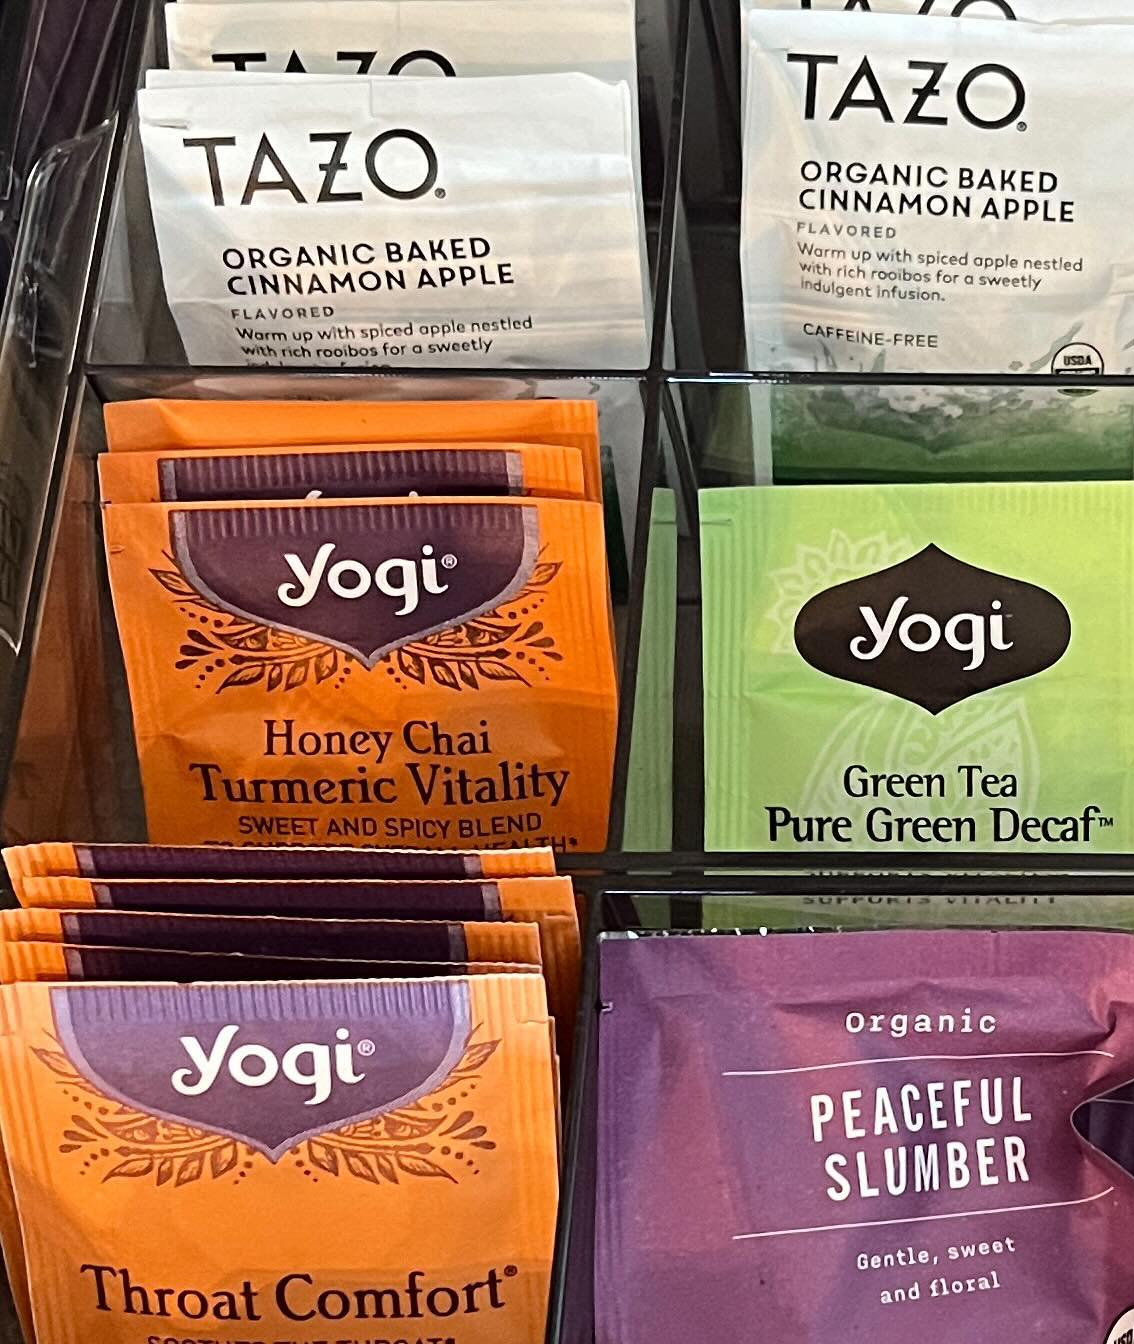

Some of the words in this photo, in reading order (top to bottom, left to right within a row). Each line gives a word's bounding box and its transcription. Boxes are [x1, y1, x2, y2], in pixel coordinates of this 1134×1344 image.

[801, 161, 950, 189] ORGANIC
[959, 167, 1058, 193] BAKED
[800, 189, 971, 218] CINNAMON
[981, 197, 1074, 223] APPLE
[797, 222, 897, 239] FLAVORED
[222, 243, 376, 269] ORGANIC
[386, 237, 490, 263] BAKED
[798, 242, 846, 260] Warm
[851, 251, 871, 264] up
[877, 249, 912, 264] with
[918, 251, 969, 268] spiced
[974, 255, 1018, 270] apple
[1024, 257, 1083, 273] nestled
[227, 269, 406, 295] CINNAMON
[418, 263, 514, 289] APPLE
[803, 323, 938, 348] CAFFEINE-FREE
[264, 719, 392, 763] Honey
[403, 720, 492, 754] Chai
[189, 763, 397, 805] Turmeric
[406, 762, 570, 807] Vitality
[843, 766, 946, 798] Green
[958, 766, 1018, 797] Tea
[238, 815, 320, 835] SWEET
[327, 816, 378, 836] AND
[385, 817, 451, 839] SPICY
[459, 813, 541, 835] BLEND
[765, 806, 852, 843] Pure
[867, 807, 977, 842] Green
[845, 1008, 997, 1037] Organic
[810, 1076, 1032, 1142] PEACEFUL
[825, 1136, 1030, 1202] SLUMBER
[856, 1246, 940, 1271] Gentle,
[947, 1237, 1015, 1260] sweet
[81, 1264, 261, 1321] Throat
[880, 1283, 920, 1304] and
[929, 1271, 1000, 1298] floral
